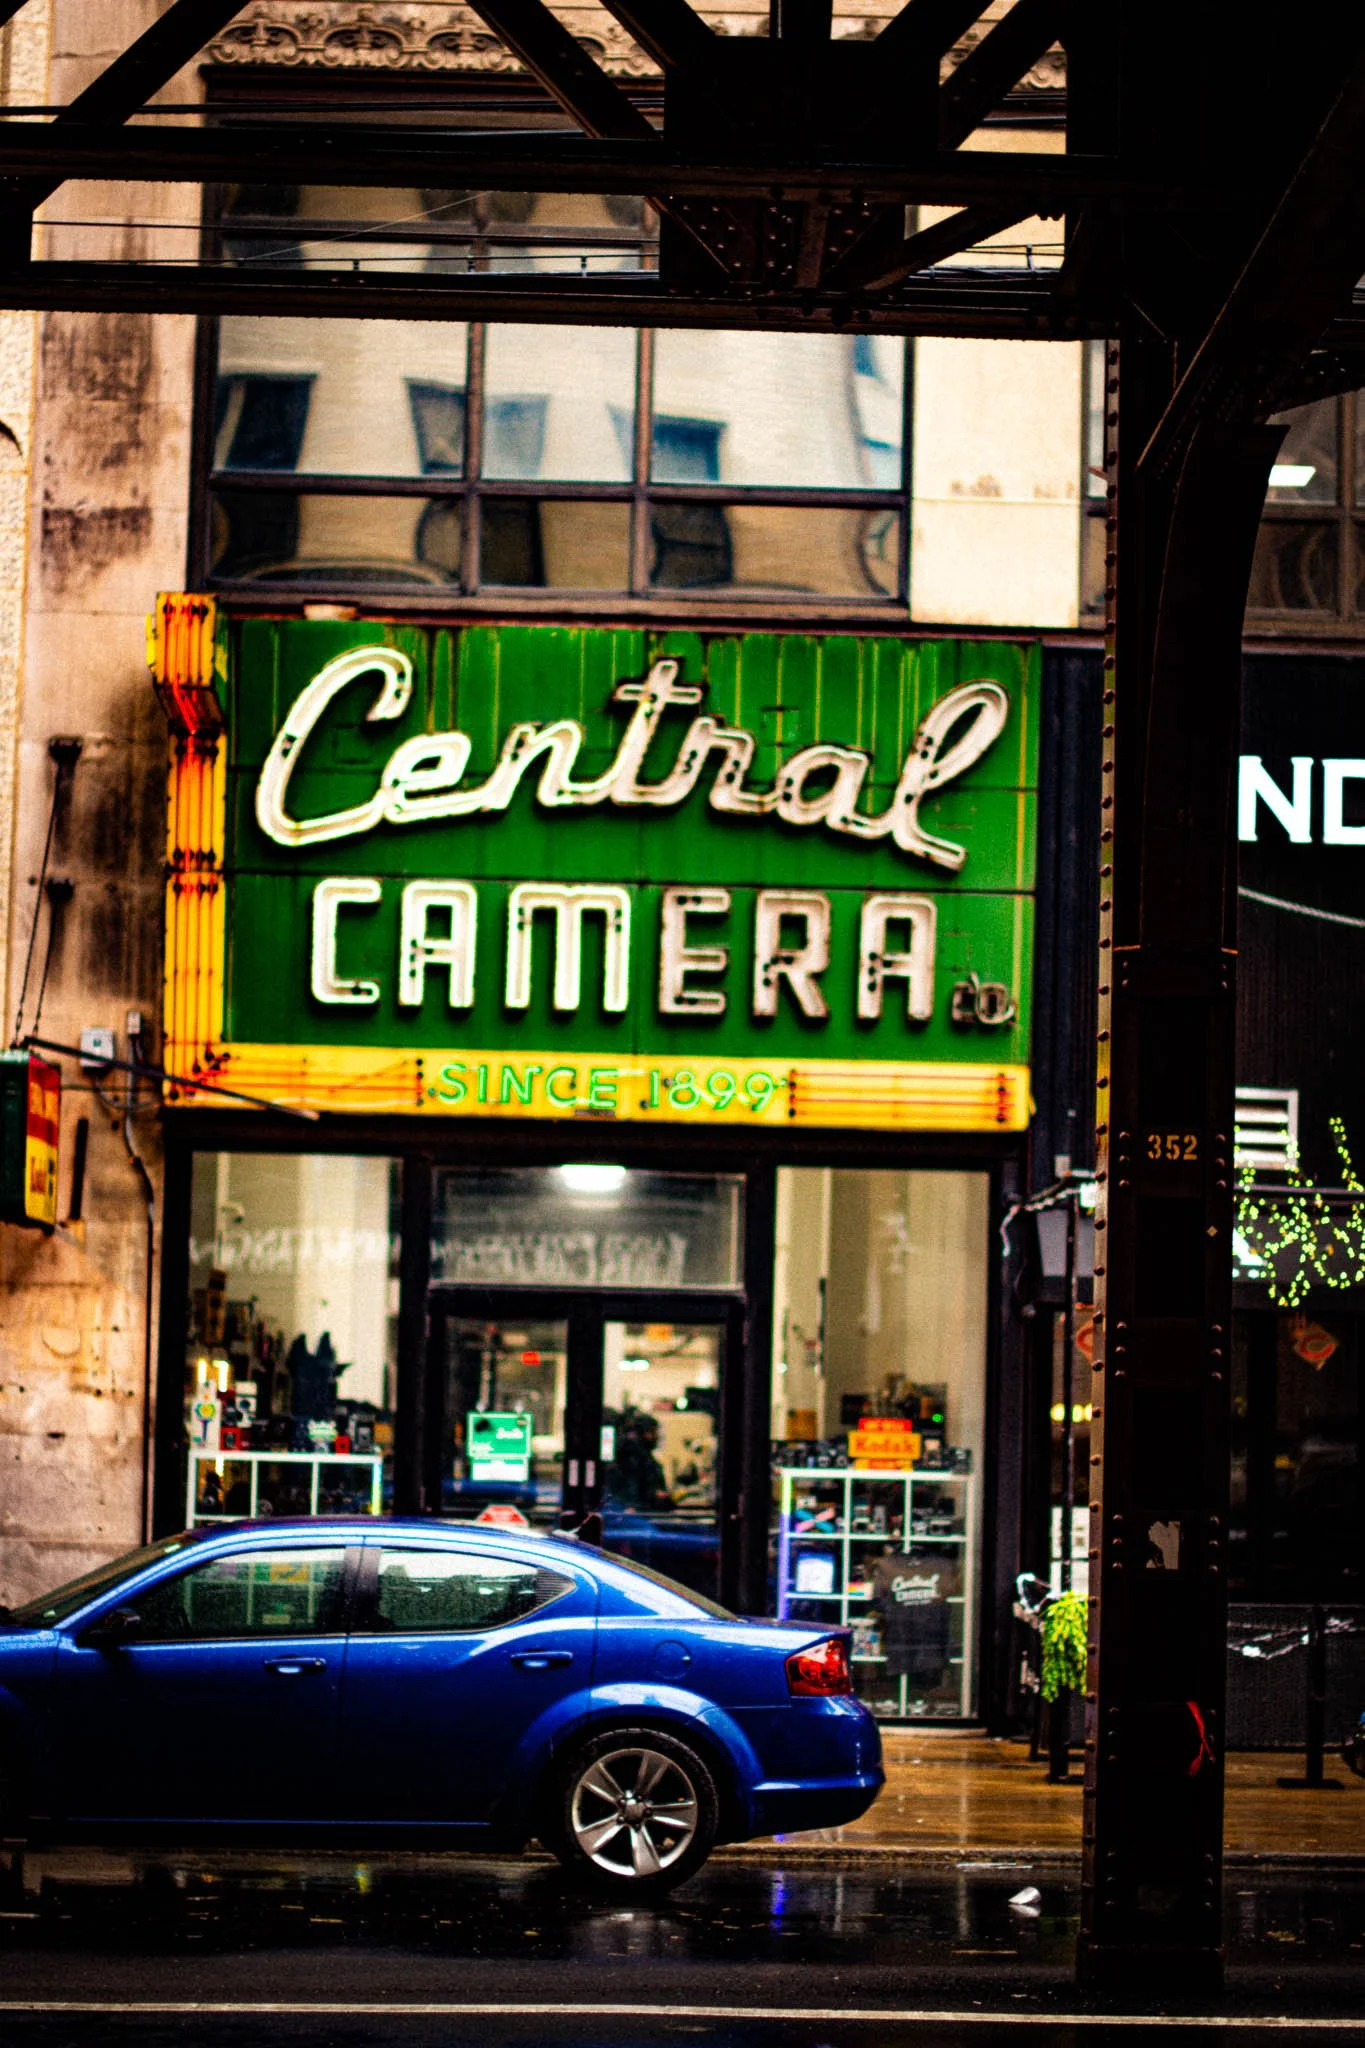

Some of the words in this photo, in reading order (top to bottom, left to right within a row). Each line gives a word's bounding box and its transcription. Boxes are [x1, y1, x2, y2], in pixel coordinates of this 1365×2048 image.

[255, 643, 1010, 871] Central
[311, 876, 938, 1021] CAMERA
[438, 1063, 617, 1109] SINCE
[650, 1069, 776, 1112] 1899
[1147, 1134, 1198, 1160] 352
